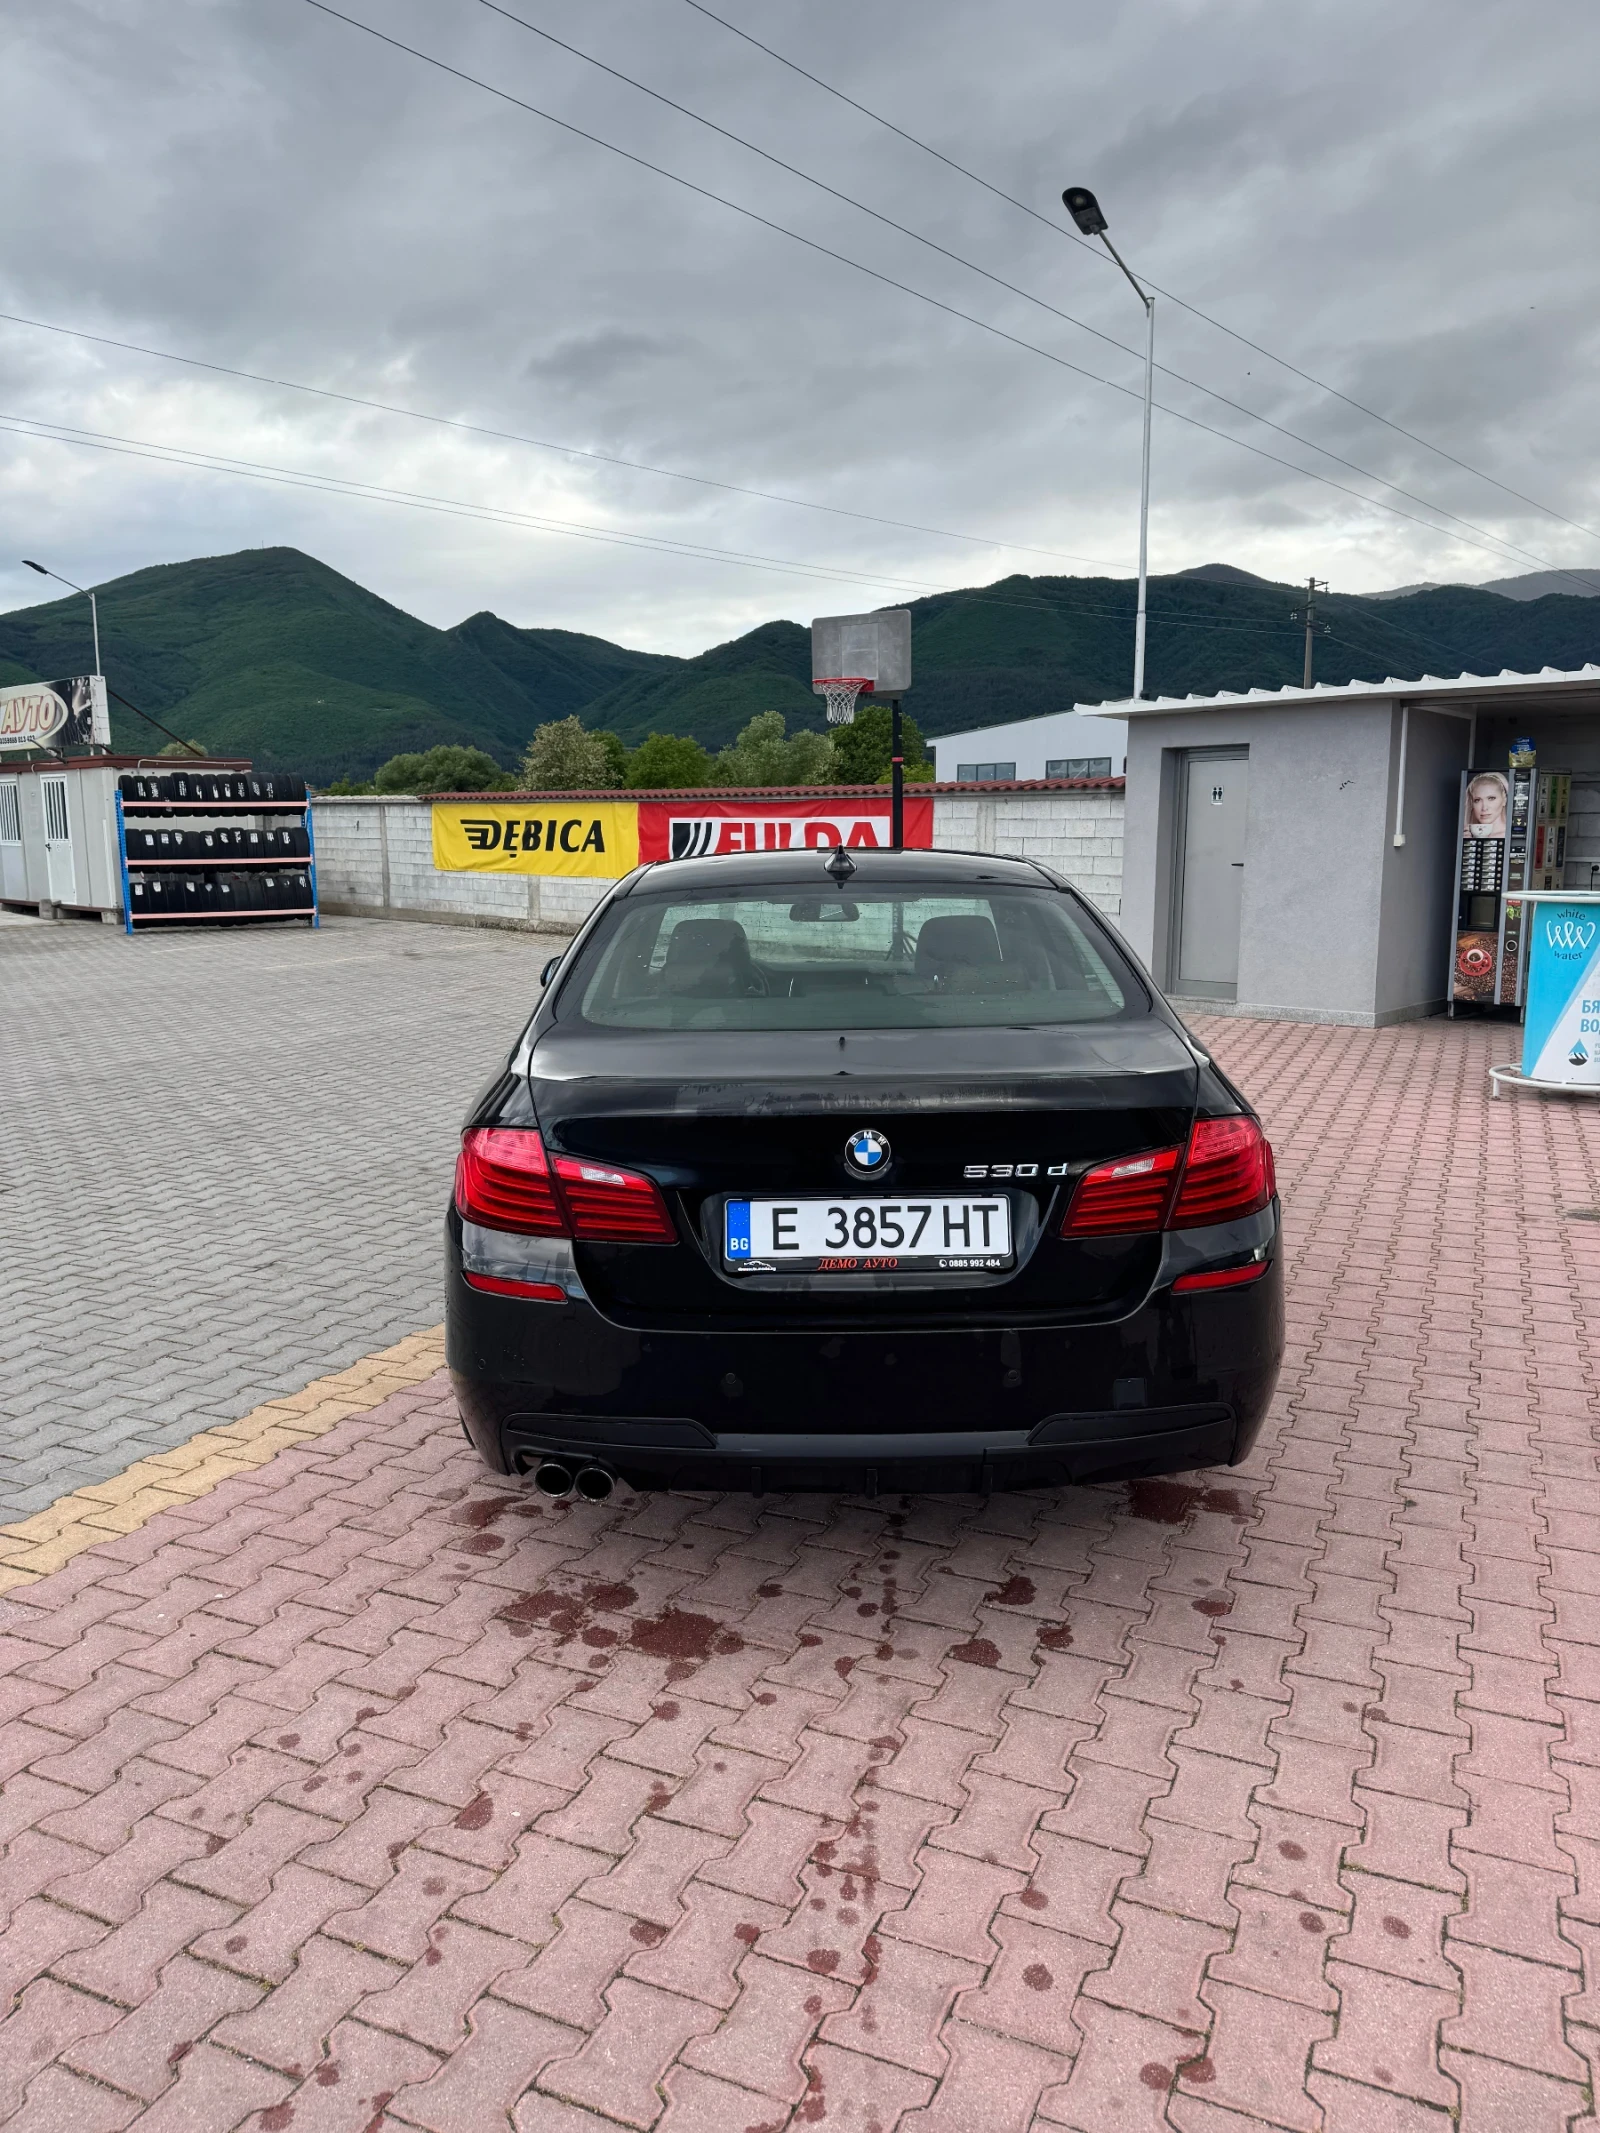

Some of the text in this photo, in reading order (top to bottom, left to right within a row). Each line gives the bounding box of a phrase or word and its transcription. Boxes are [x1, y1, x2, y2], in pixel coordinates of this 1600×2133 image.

[1557, 909, 1586, 920] white
[1554, 950, 1583, 960] water
[1580, 1019, 1600, 1034] ВО
[849, 1131, 887, 1146] BMW
[963, 1163, 1068, 1178] 530 d
[772, 1205, 999, 1250] E 3857 HT
[731, 1238, 749, 1250] BG
[817, 1258, 898, 1271] ДЕМО АУТО
[948, 1259, 1001, 1267] 0885 992 484
